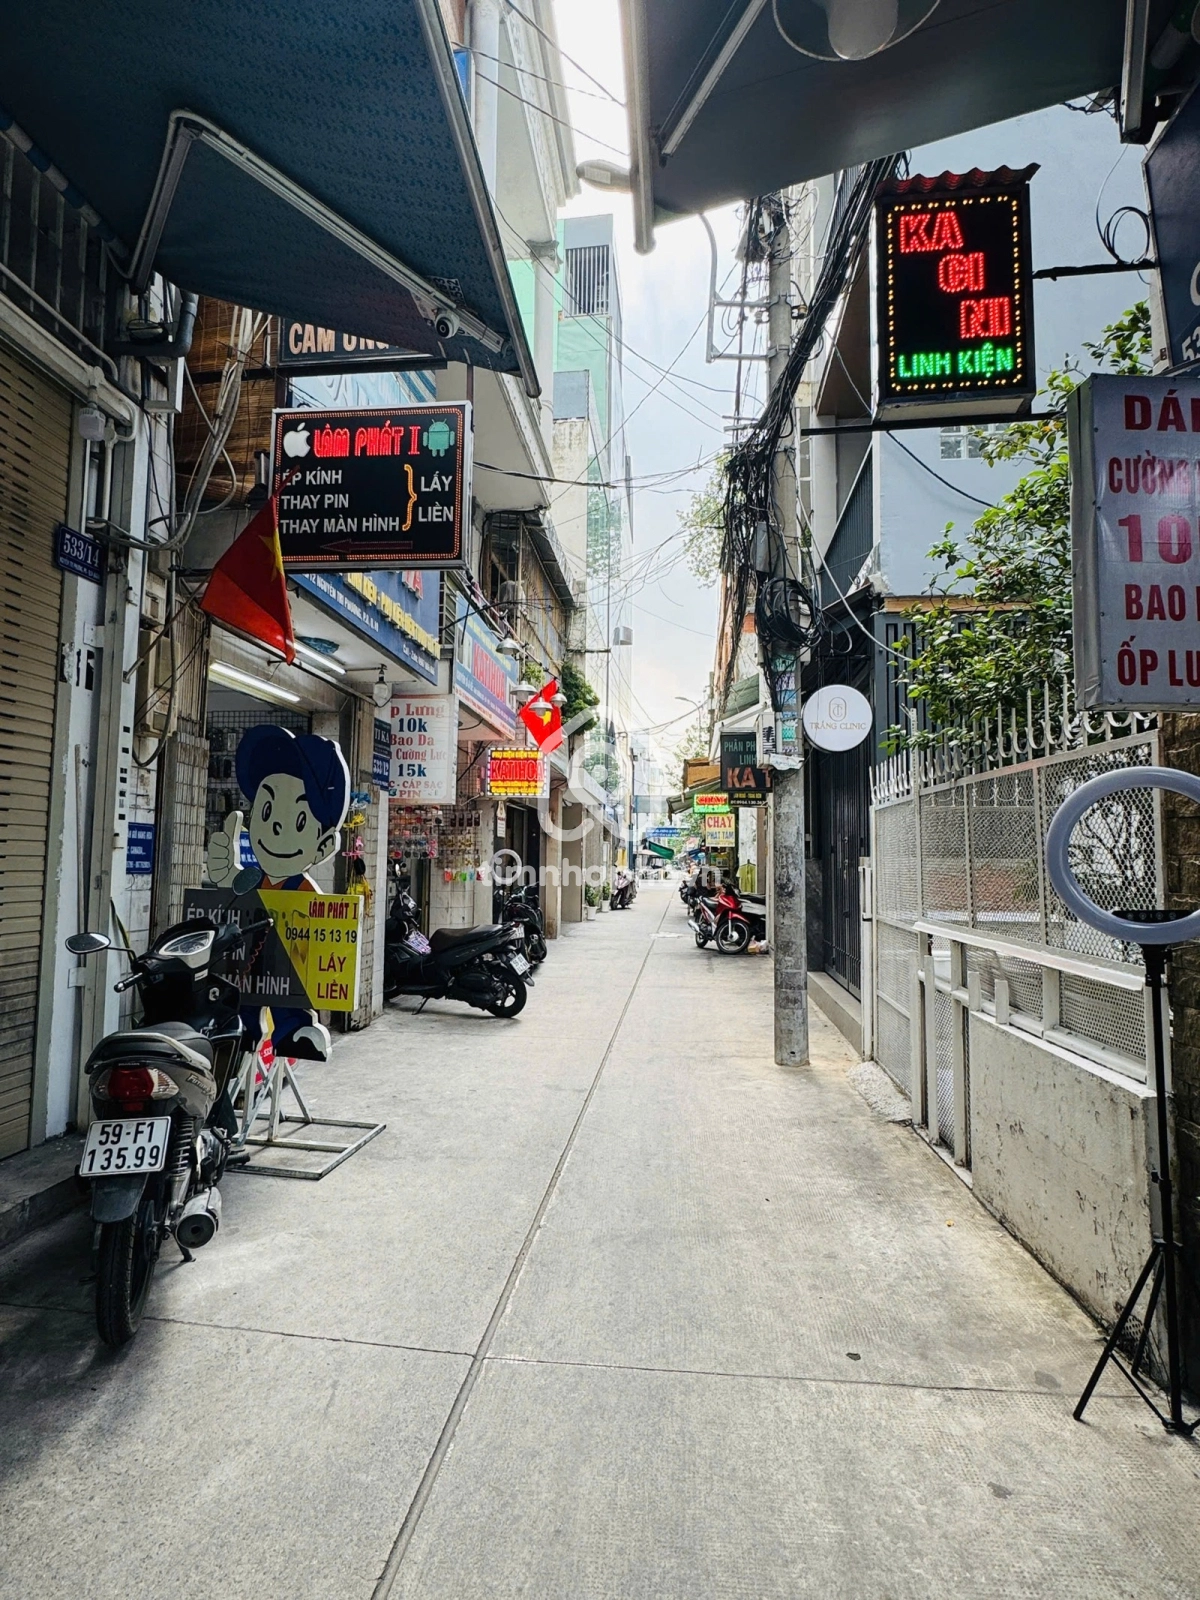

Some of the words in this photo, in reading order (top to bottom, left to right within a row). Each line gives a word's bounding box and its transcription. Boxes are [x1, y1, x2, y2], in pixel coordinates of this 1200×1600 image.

[900, 211, 963, 253] KA
[898, 352, 951, 378] LINH
[957, 342, 1014, 378] KIỆN
[313, 423, 350, 458] LÂM
[354, 420, 404, 457] PHÁT
[282, 469, 302, 486] ÉP
[305, 467, 343, 486] KÍNH
[420, 471, 453, 492] LẤY
[281, 494, 321, 510] THAY
[324, 493, 349, 509] PIN
[418, 502, 454, 522] LIỀN
[280, 518, 320, 534] THAY
[323, 514, 358, 533] MÀN
[362, 513, 400, 532] HÌNH
[1118, 513, 1200, 565] 10
[1125, 584, 1186, 622] BAO
[1117, 635, 1158, 686] ỐP
[398, 717, 428, 733] 10k
[839, 722, 866, 730] CLINIC
[389, 733, 414, 746] Bao
[724, 739, 744, 752] PHÂN
[745, 741, 757, 752] PH
[397, 763, 427, 777] 15k
[739, 754, 757, 766] LINH
[726, 767, 756, 788] KA
[706, 815, 733, 829] CHAY
[308, 897, 325, 919] LÂM
[327, 898, 349, 920] PHÁT
[285, 927, 311, 941] 0944
[313, 928, 326, 942] 15
[329, 929, 342, 943] 13
[345, 930, 358, 944] 19
[319, 952, 347, 973] LẤY
[256, 971, 290, 996] HÌNH
[317, 979, 349, 1001] LIỀN
[98, 1121, 155, 1146] 59-F1
[87, 1145, 161, 1172] 135.99
